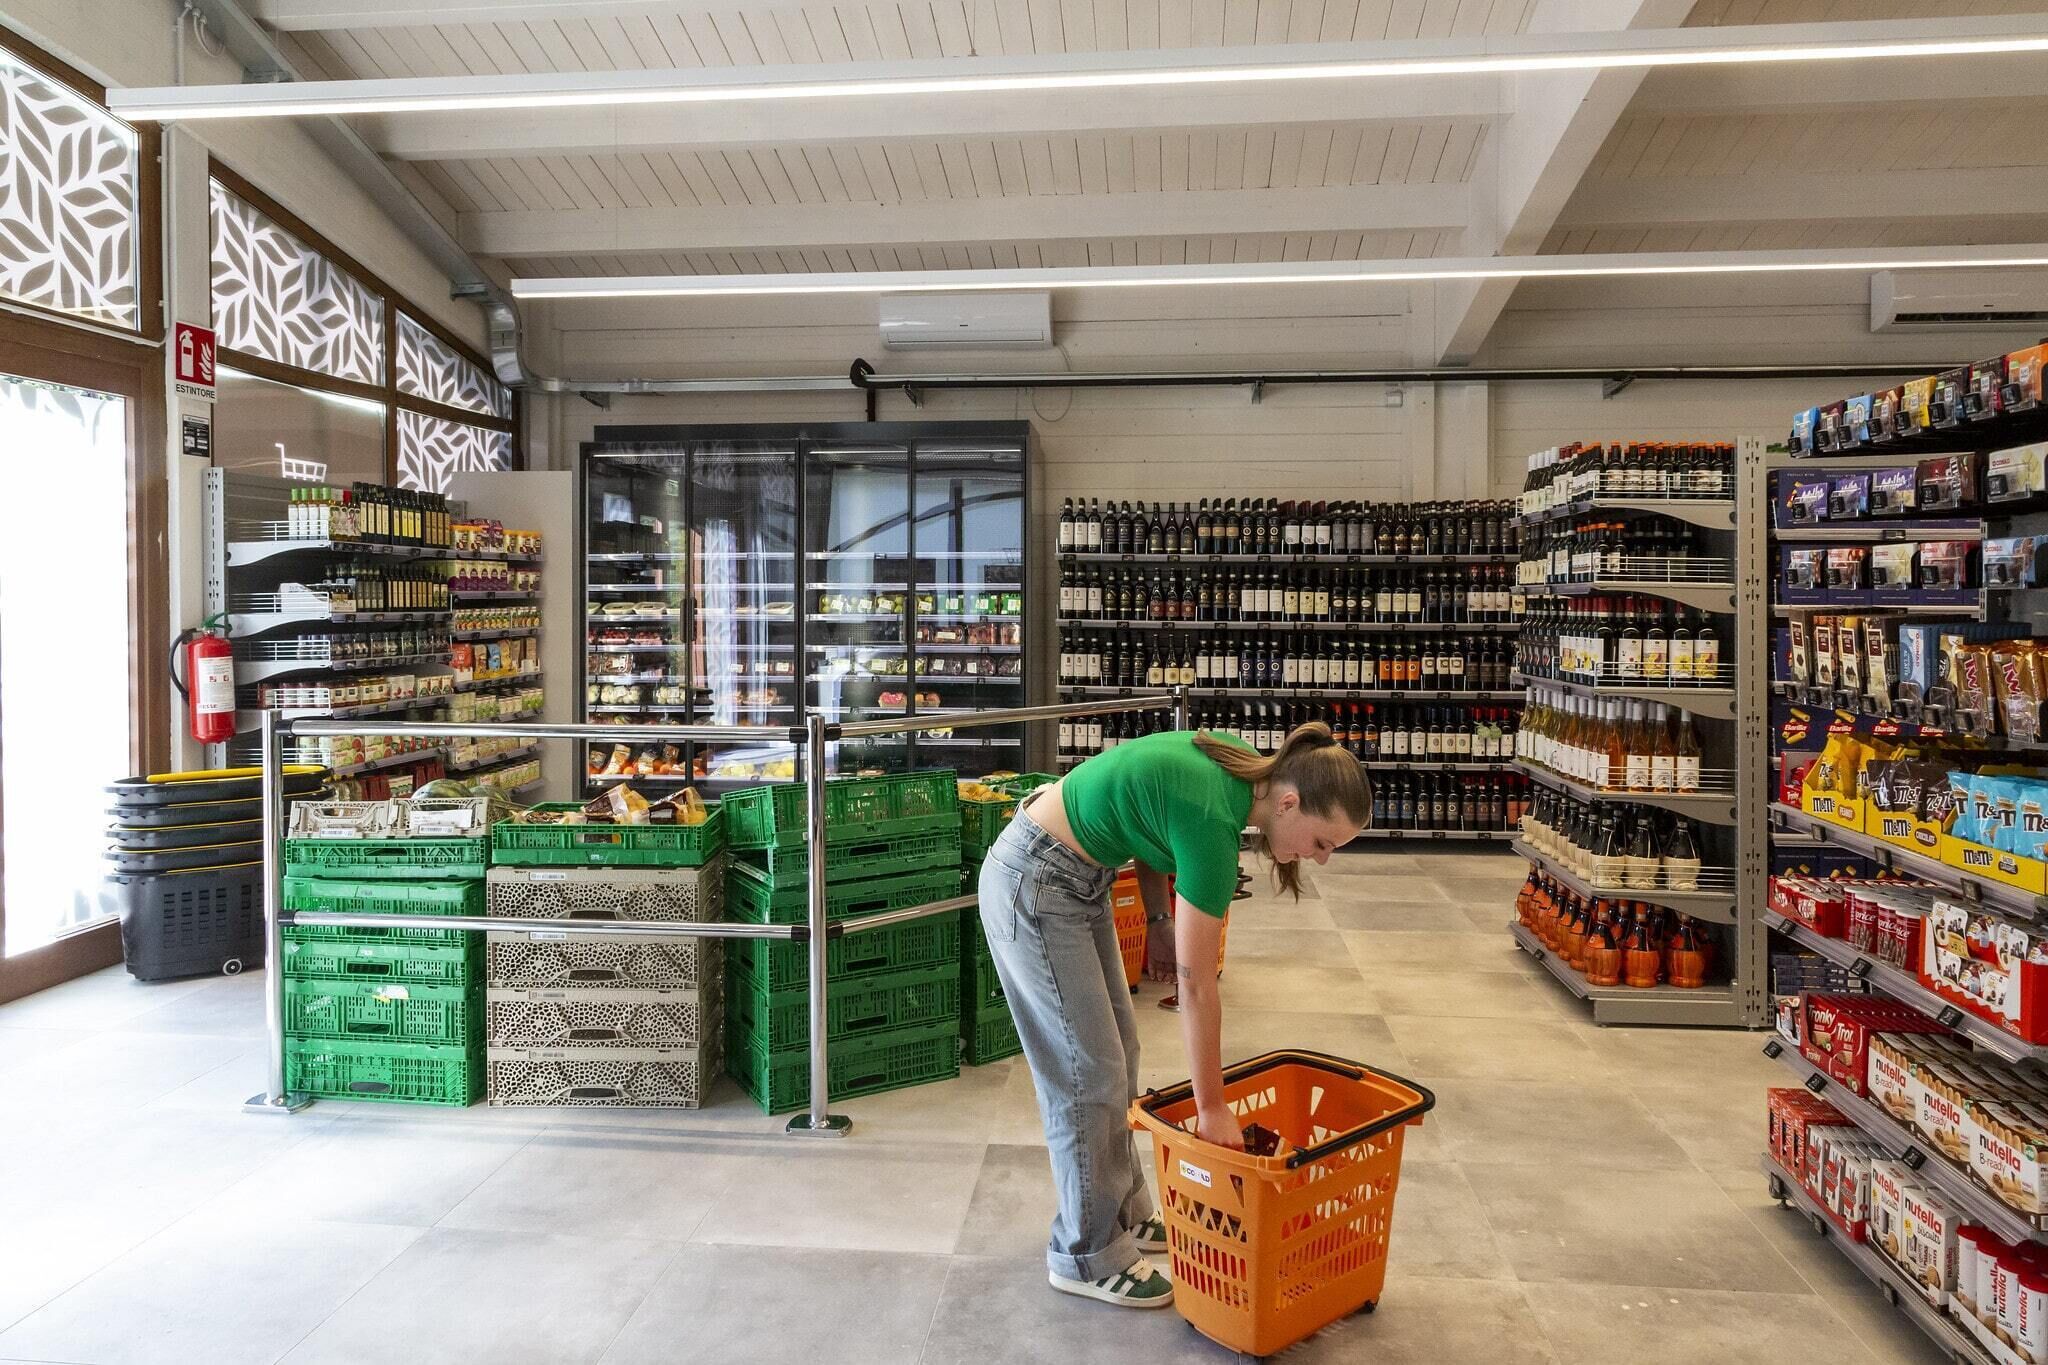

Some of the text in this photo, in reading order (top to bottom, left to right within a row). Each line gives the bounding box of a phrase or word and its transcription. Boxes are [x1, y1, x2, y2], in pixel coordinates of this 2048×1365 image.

[175, 383, 216, 399] ESTINTORE
[1785, 724, 1808, 732] Barilla
[1829, 725, 1853, 733] Barilla
[1808, 1005, 1836, 1028] Tronky
[1875, 1058, 1906, 1088] nutella
[1875, 1074, 1895, 1091] B-ready
[1924, 1092, 1960, 1126] nutella
[1924, 1110, 1947, 1129] B-ready
[1979, 1133, 2021, 1171] nutella
[1979, 1152, 2006, 1175] B-ready
[1186, 1167, 1211, 1183] COAD
[1872, 1167, 1900, 1203] nutella
[1904, 1197, 1942, 1236] nutella
[1917, 1223, 1941, 1245] biscuits
[1998, 1272, 2007, 1319] nutella
[2019, 1290, 2028, 1337] nutella
